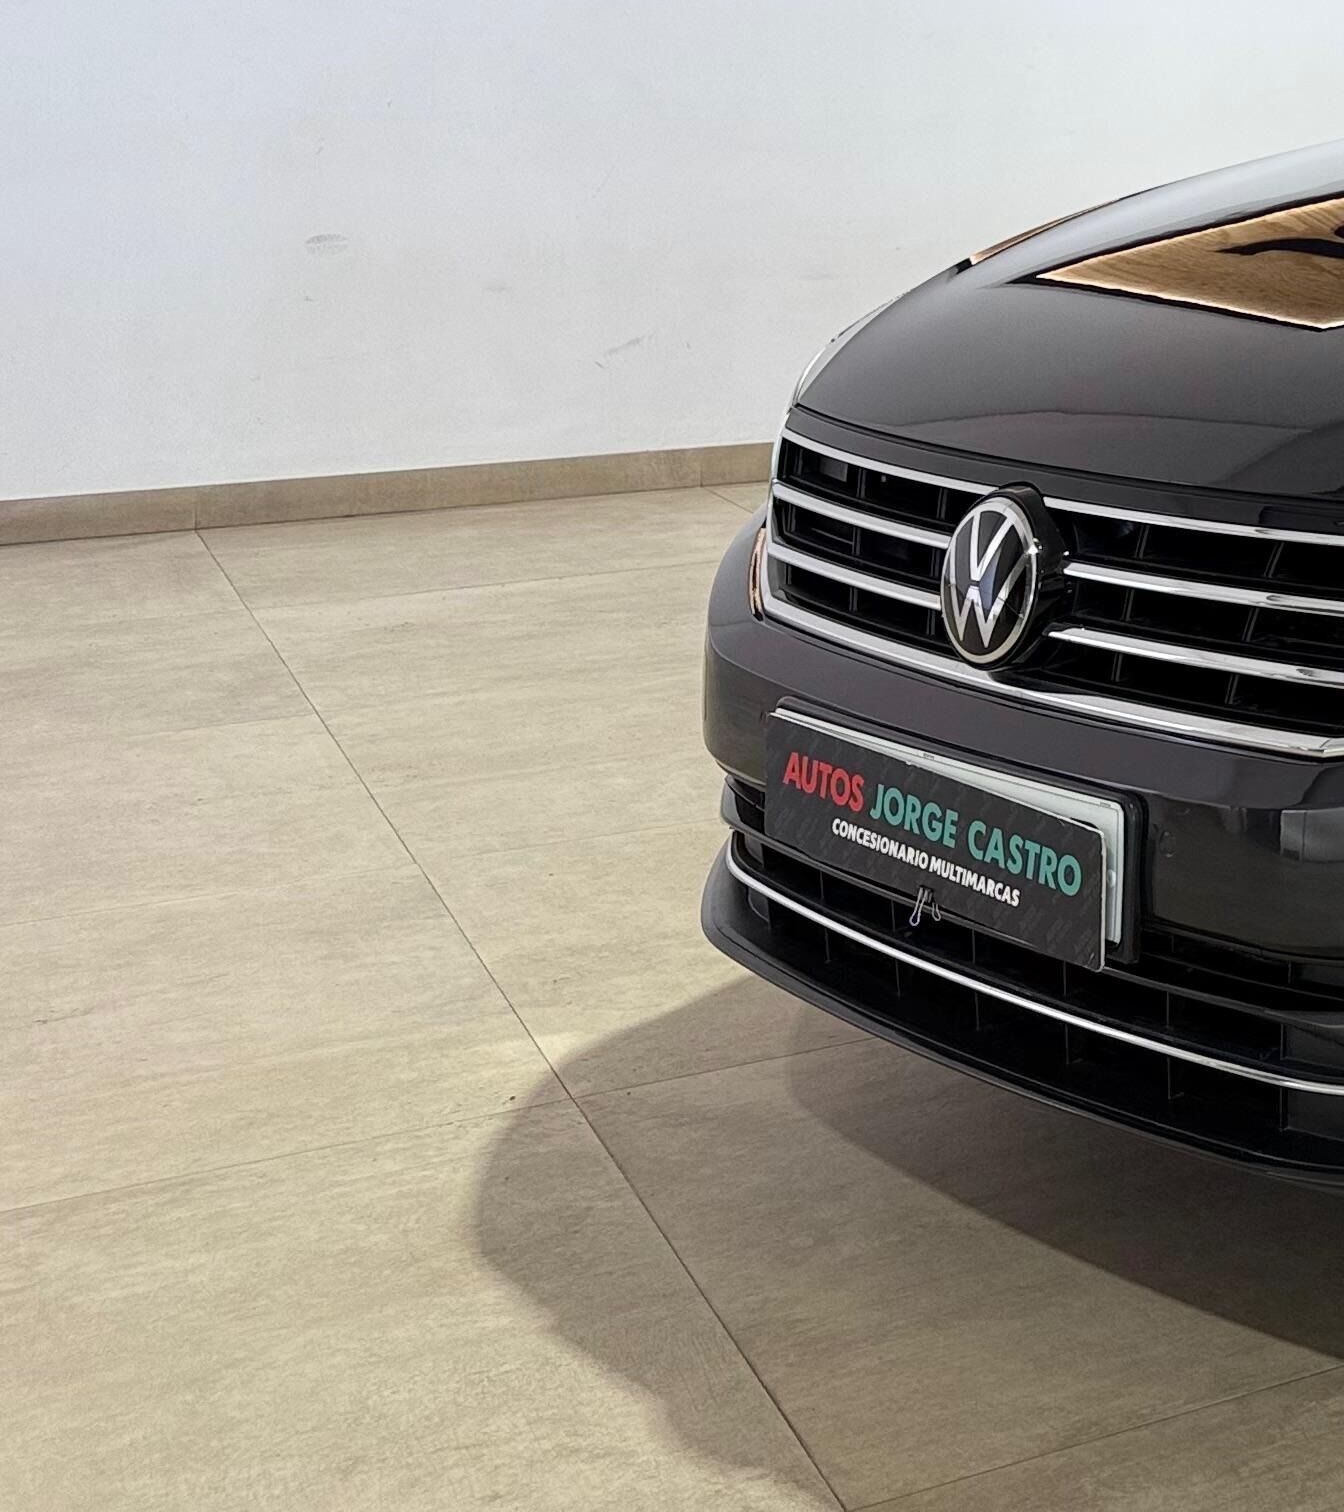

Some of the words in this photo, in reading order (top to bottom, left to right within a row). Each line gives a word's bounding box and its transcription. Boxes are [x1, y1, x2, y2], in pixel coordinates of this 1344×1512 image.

[783, 752, 865, 812] AUTOS
[869, 784, 960, 849] JORGE
[967, 820, 1082, 897] CASTRO
[832, 817, 929, 870] CONCESIONARIO
[928, 855, 1021, 907] MULTIMARCAS
